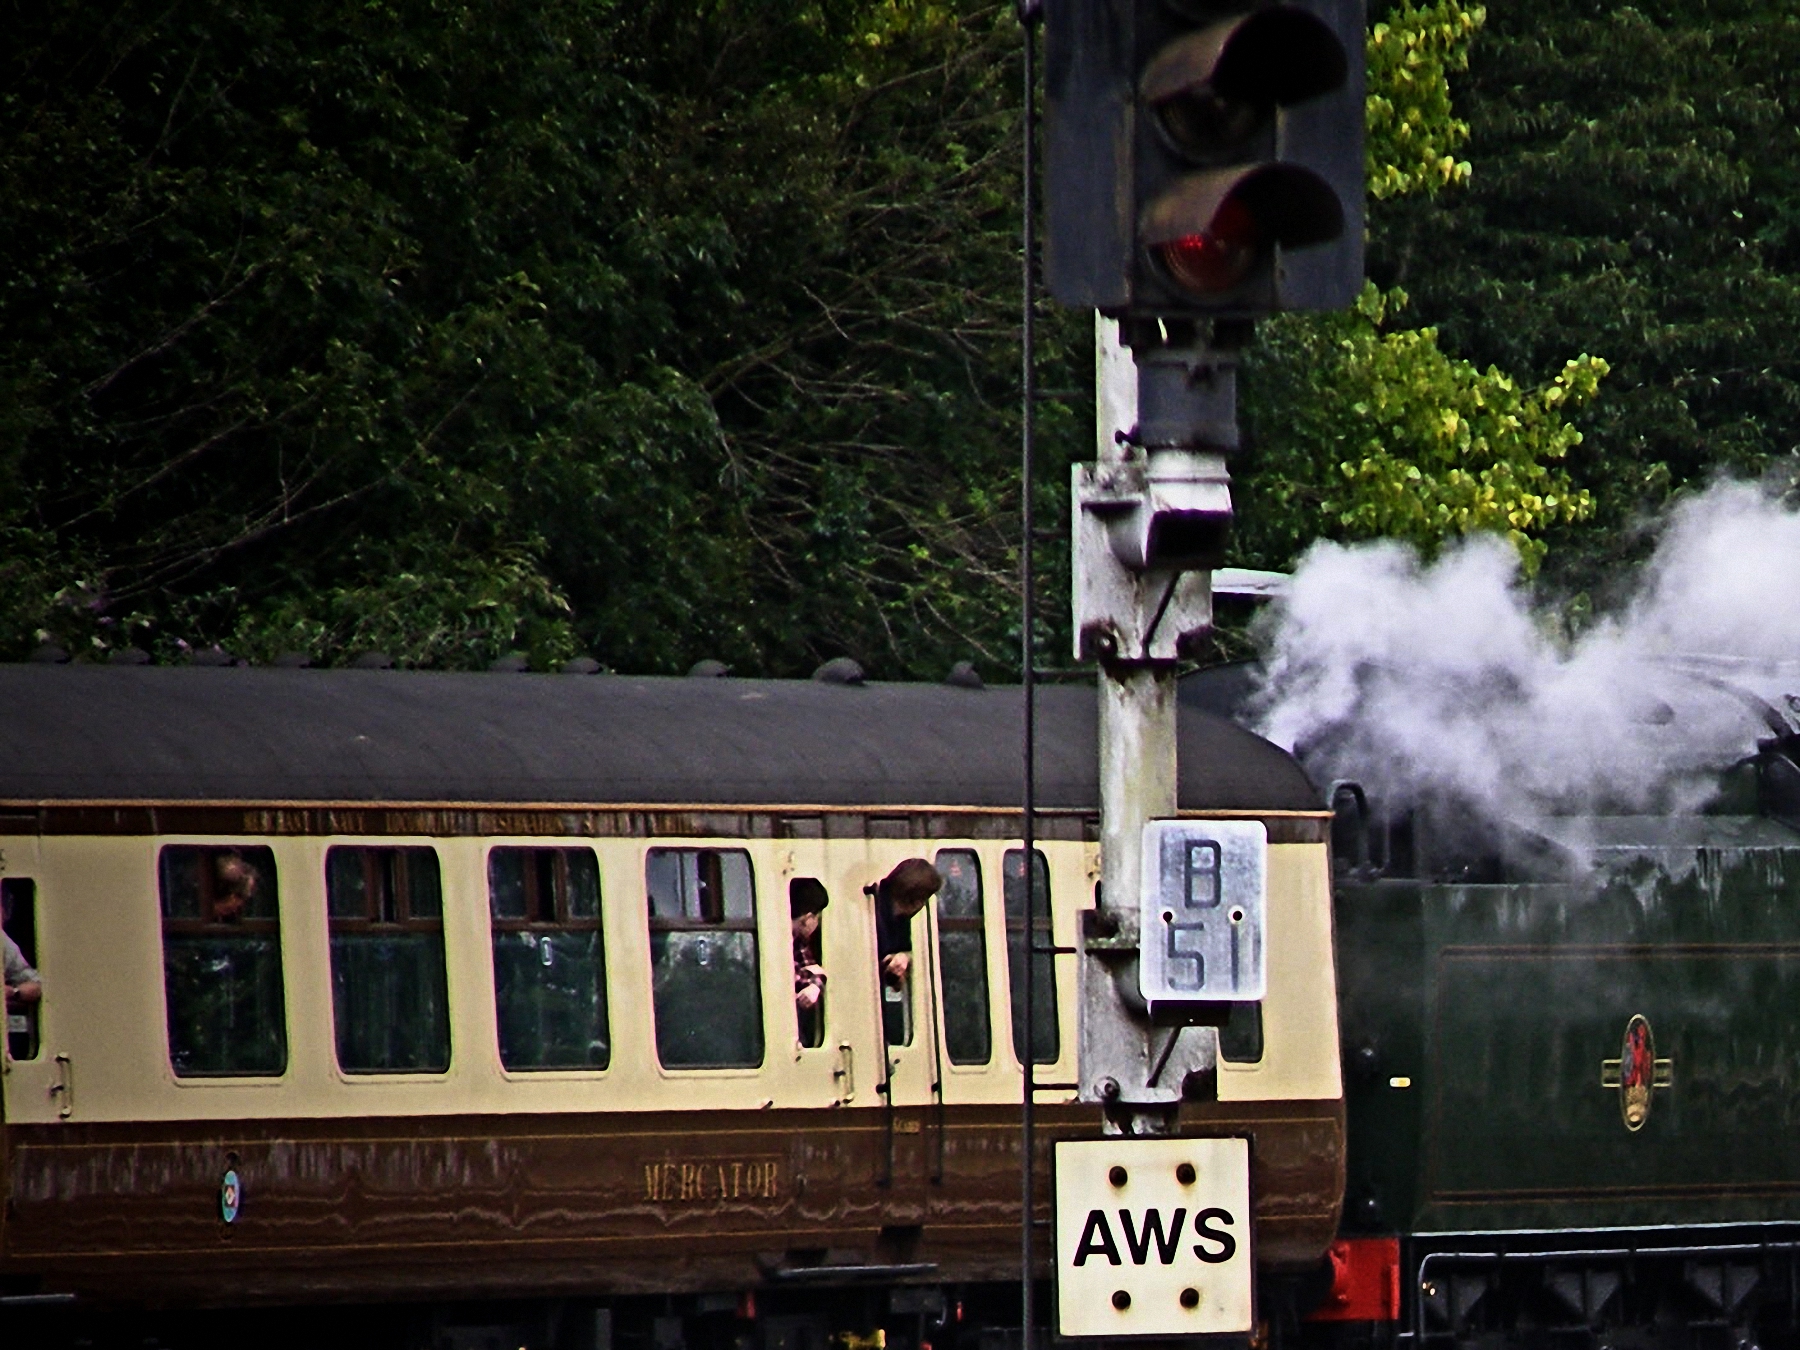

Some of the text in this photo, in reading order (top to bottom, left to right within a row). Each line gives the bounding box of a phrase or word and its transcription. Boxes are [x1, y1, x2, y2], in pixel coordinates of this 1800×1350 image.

[1185, 839, 1222, 908] B
[1168, 922, 1240, 992] 51
[645, 1162, 777, 1200] MERCATOR
[1073, 1207, 1236, 1266] AWS
